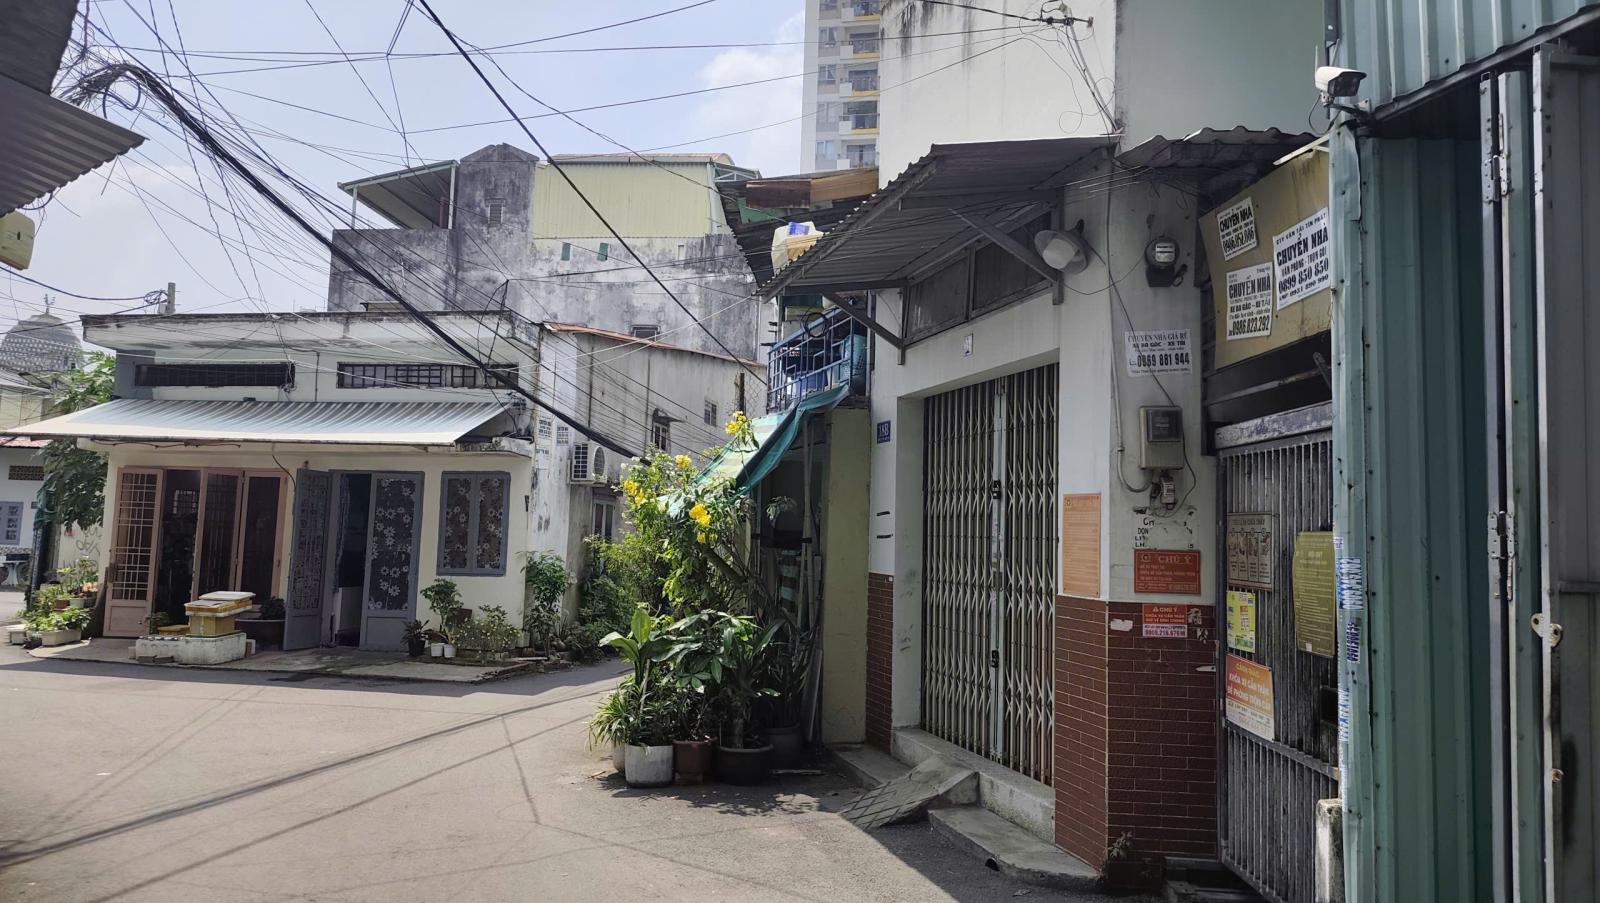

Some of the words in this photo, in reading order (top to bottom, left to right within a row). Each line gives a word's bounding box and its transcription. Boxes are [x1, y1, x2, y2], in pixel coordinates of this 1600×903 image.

[1276, 232, 1309, 267] CHUYỂN
[1311, 222, 1329, 250] NHÀ
[1229, 274, 1256, 299] CHUYỂN
[1257, 272, 1271, 293] NHÀ
[1278, 273, 1297, 295] 0899
[1298, 266, 1313, 285] 850
[1314, 257, 1329, 277] 850
[1159, 353, 1172, 366] 881
[1174, 352, 1190, 366] 944
